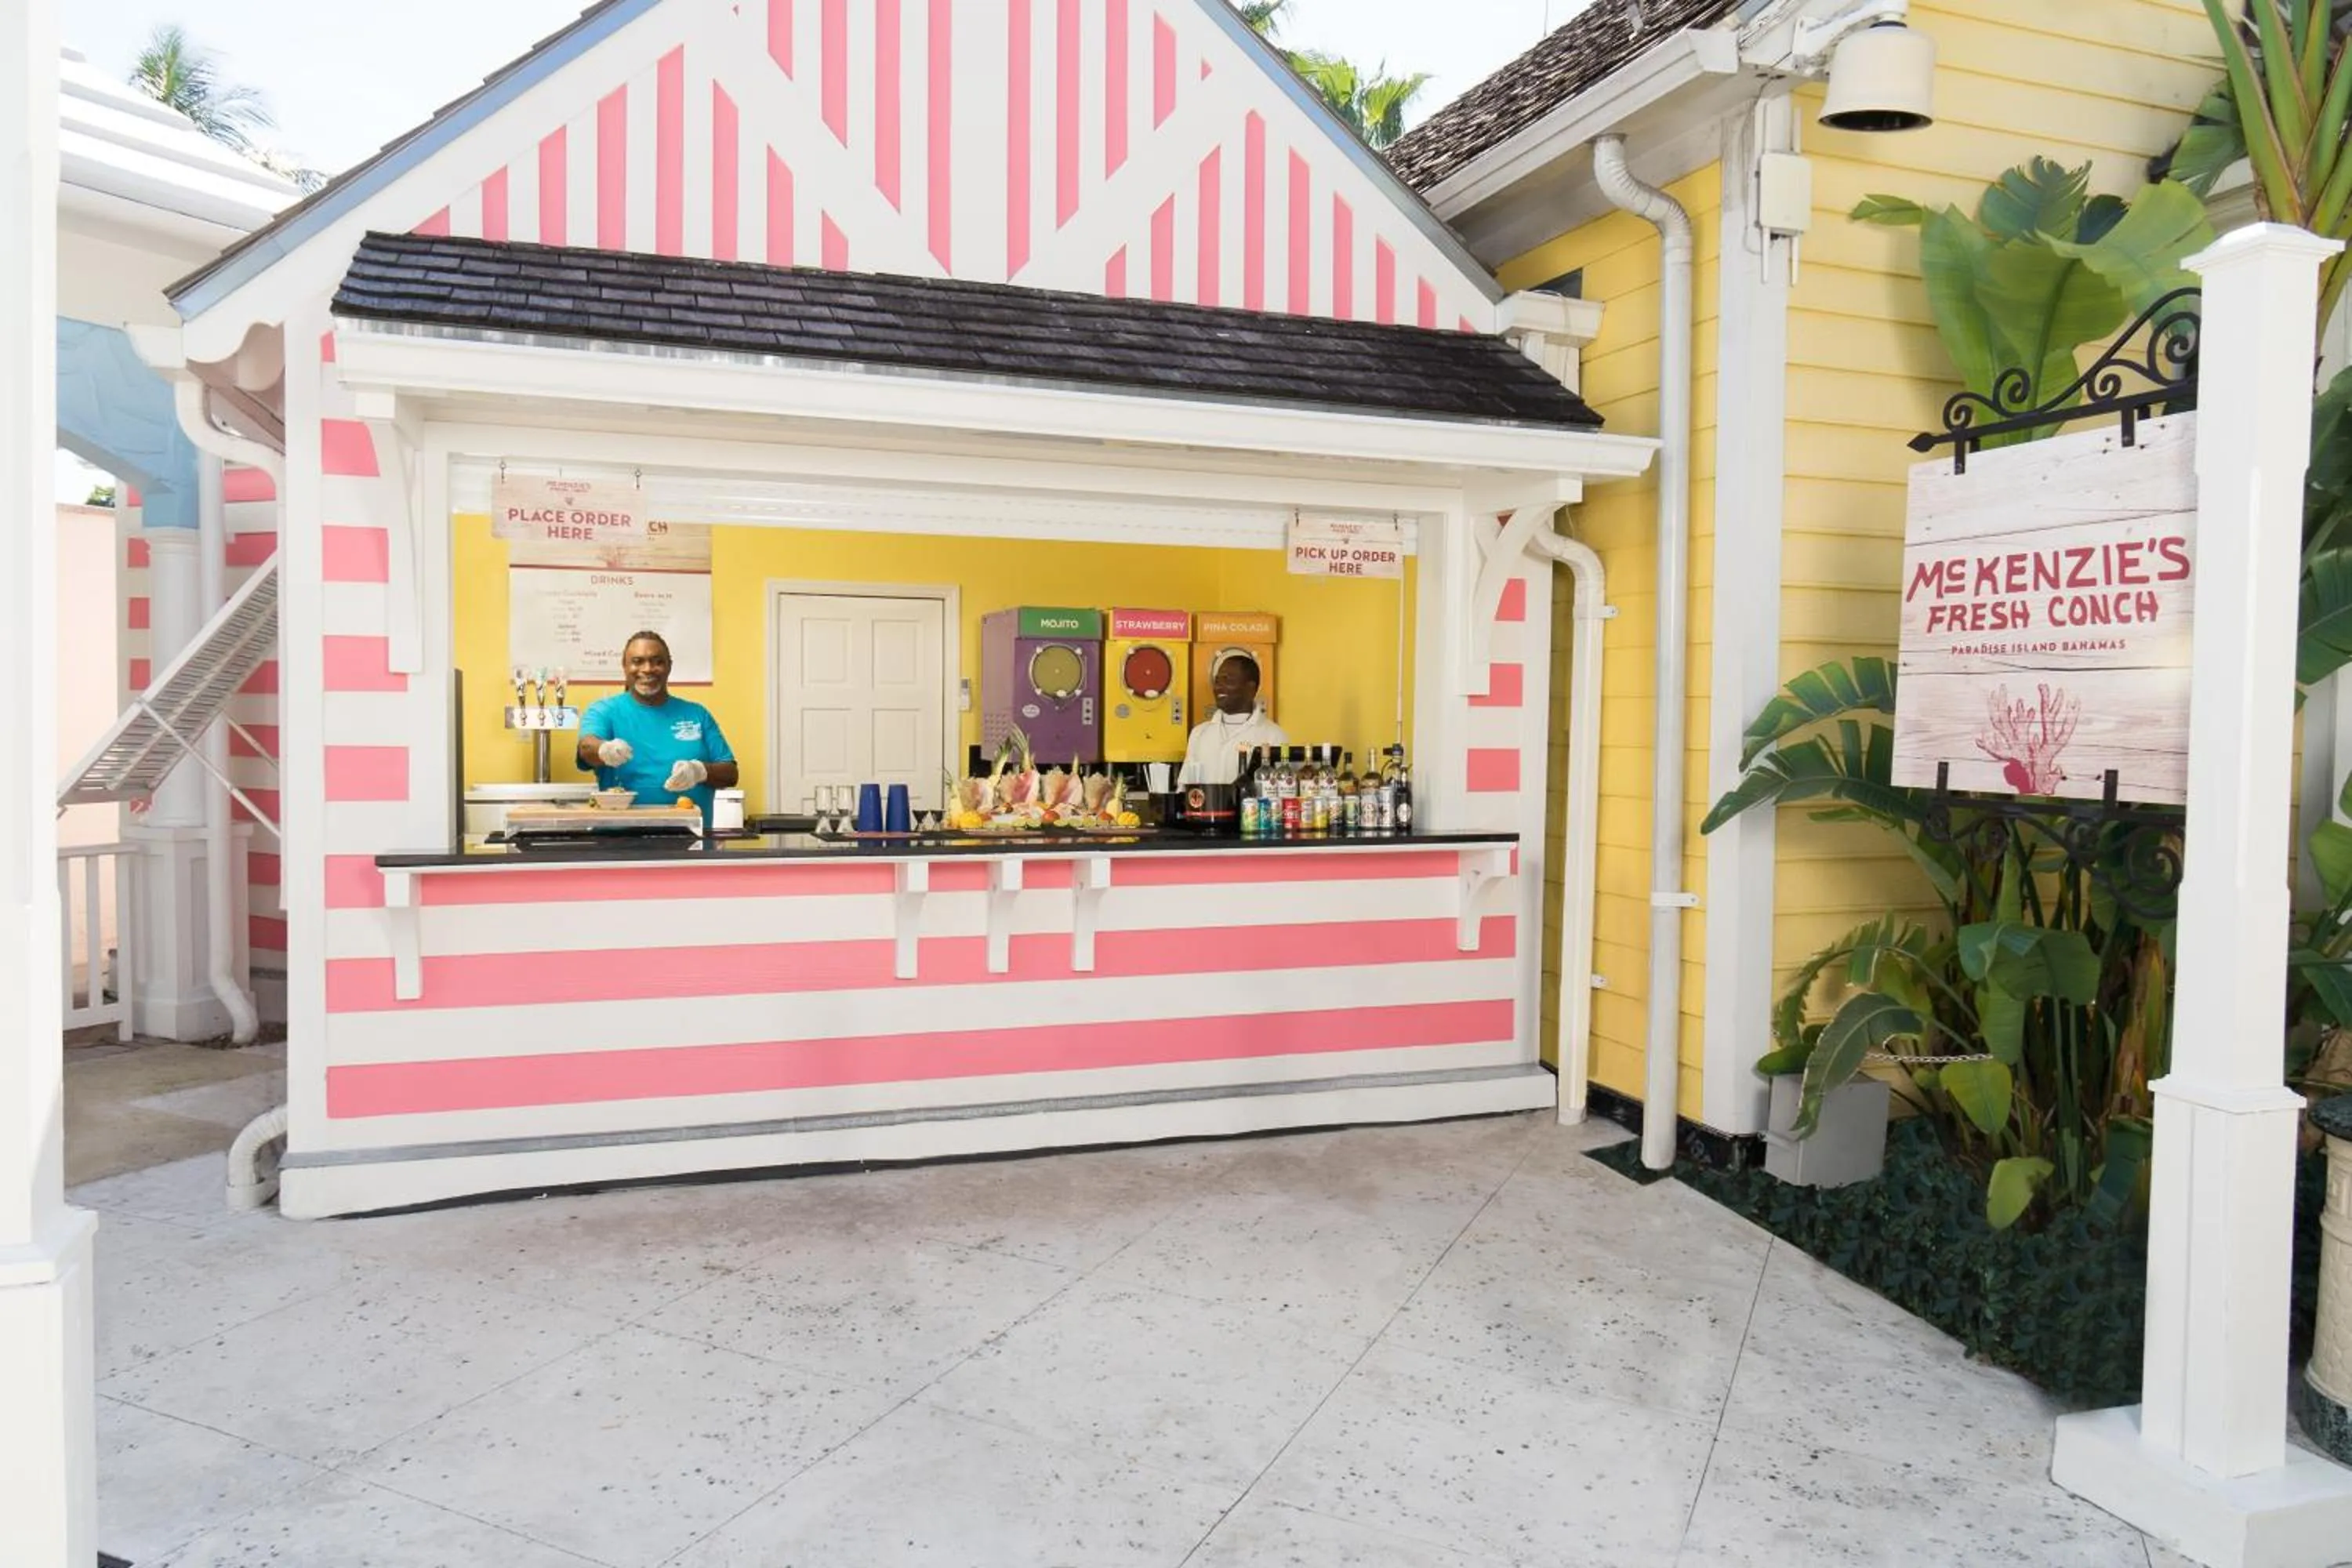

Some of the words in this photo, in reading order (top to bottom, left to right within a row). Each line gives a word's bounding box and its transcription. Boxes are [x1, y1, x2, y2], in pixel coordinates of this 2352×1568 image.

[508, 509, 564, 524] PLACE
[571, 512, 632, 527] ORDER
[547, 526, 593, 540] HERE
[1296, 546, 1326, 559] PICK
[1330, 549, 1348, 560] UP
[1352, 550, 1396, 562] ORDER
[1329, 563, 1363, 575] HERE
[590, 575, 634, 586] DRINKS
[1927, 600, 2031, 633] FRESH
[2048, 590, 2158, 626] CONCH
[1040, 619, 1079, 629] MOJITO
[1116, 619, 1185, 631] STRAWBERRY
[1230, 622, 1269, 633] COLADA
[1951, 644, 2006, 655] PARADISE
[2012, 642, 2056, 653] ISLAND
[2062, 639, 2126, 652] BAHAMAS
